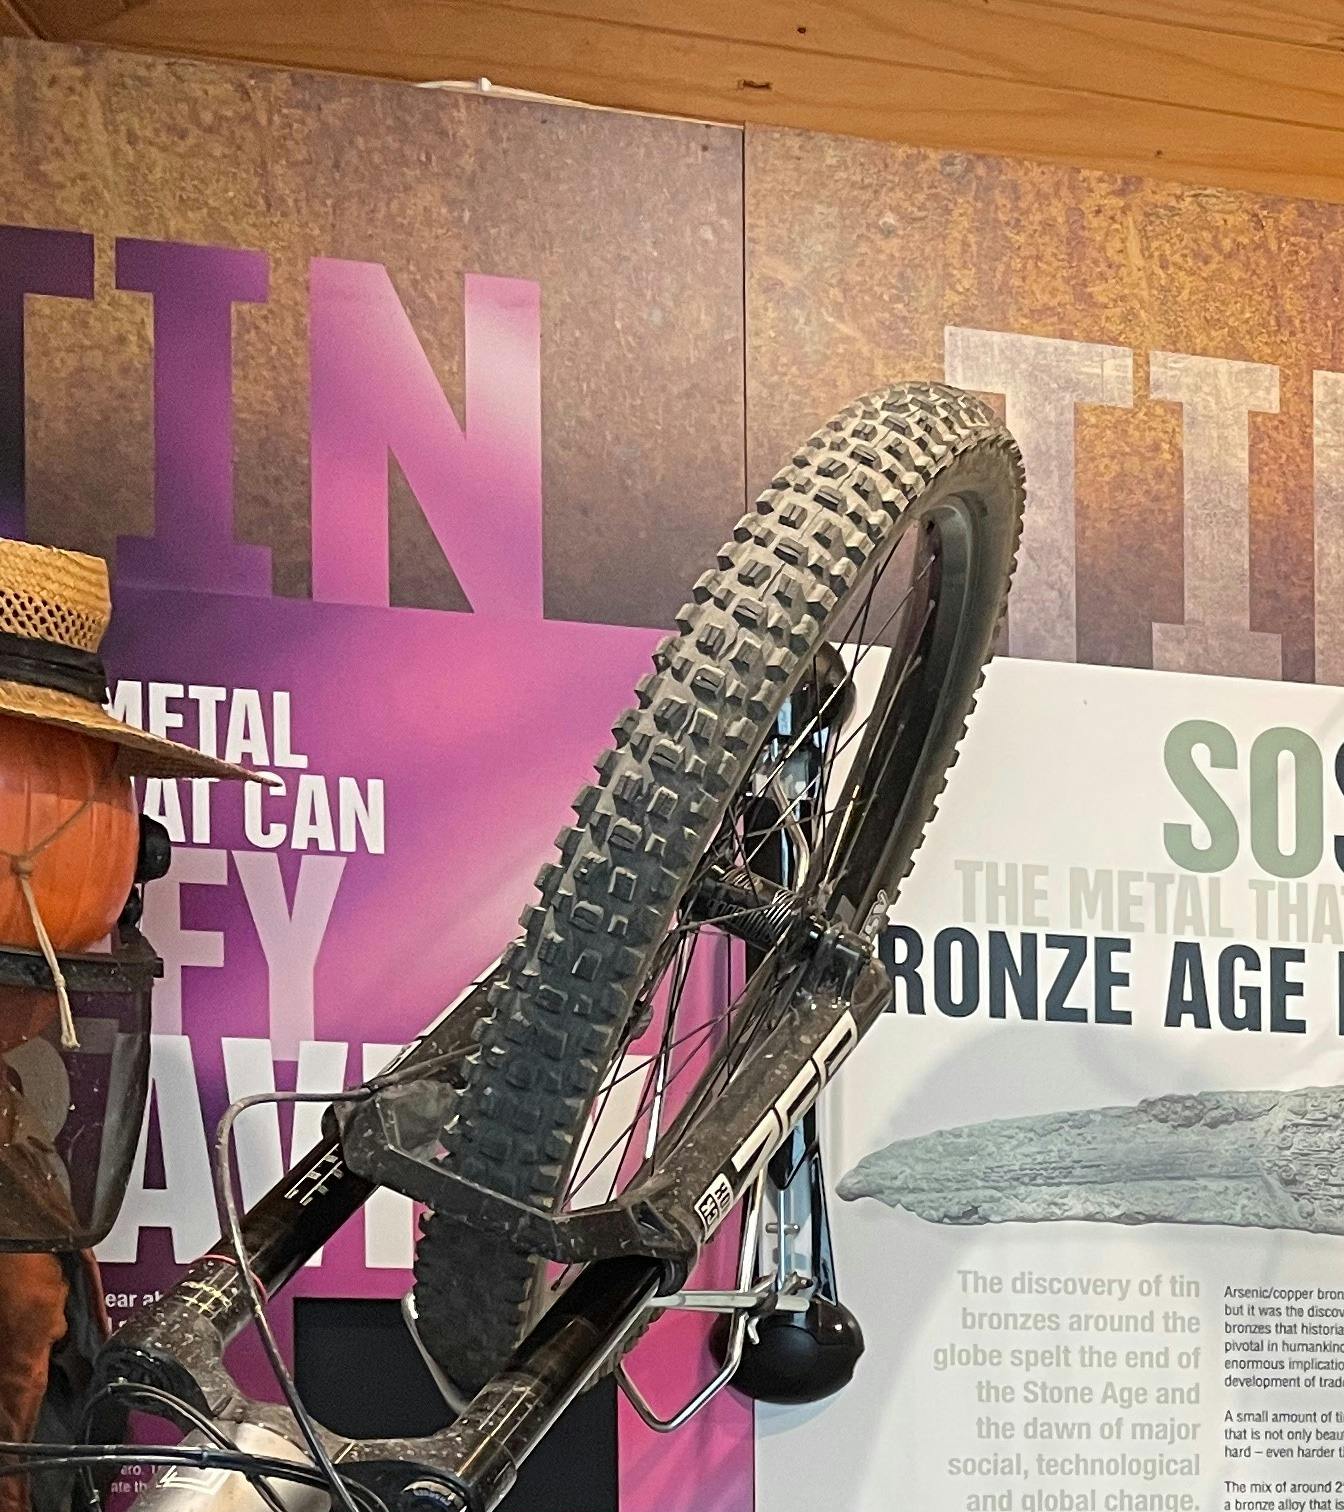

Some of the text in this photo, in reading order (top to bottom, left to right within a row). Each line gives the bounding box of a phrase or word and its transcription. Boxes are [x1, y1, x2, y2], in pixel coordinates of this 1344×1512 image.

[245, 772, 385, 855] CAN
[953, 859, 1050, 929] THE
[1070, 868, 1233, 940] METAL
[874, 925, 1133, 1027] RONZE
[1165, 941, 1305, 1034] AGE
[955, 1272, 1203, 1301] The discovery of tin
[1224, 1286, 1314, 1303] Arsenic/copper
[962, 1307, 1201, 1333] bronzes around the
[1225, 1304, 1244, 1317] but
[1247, 1304, 1255, 1317] it
[1258, 1307, 1282, 1317] was
[1286, 1304, 1304, 1318] the
[1225, 1321, 1271, 1334] bronzes
[1275, 1321, 1298, 1335] that
[933, 1344, 1202, 1371] globe spelt the end of
[974, 1381, 1200, 1408] the Stone Age and
[1225, 1409, 1233, 1422] A
[1237, 1409, 1268, 1423] small
[1272, 1410, 1318, 1423] amount
[1321, 1410, 1333, 1423] of
[976, 1417, 1202, 1444] the dawn of major
[947, 1453, 1200, 1479] social, technological
[966, 1490, 1018, 1512] and
